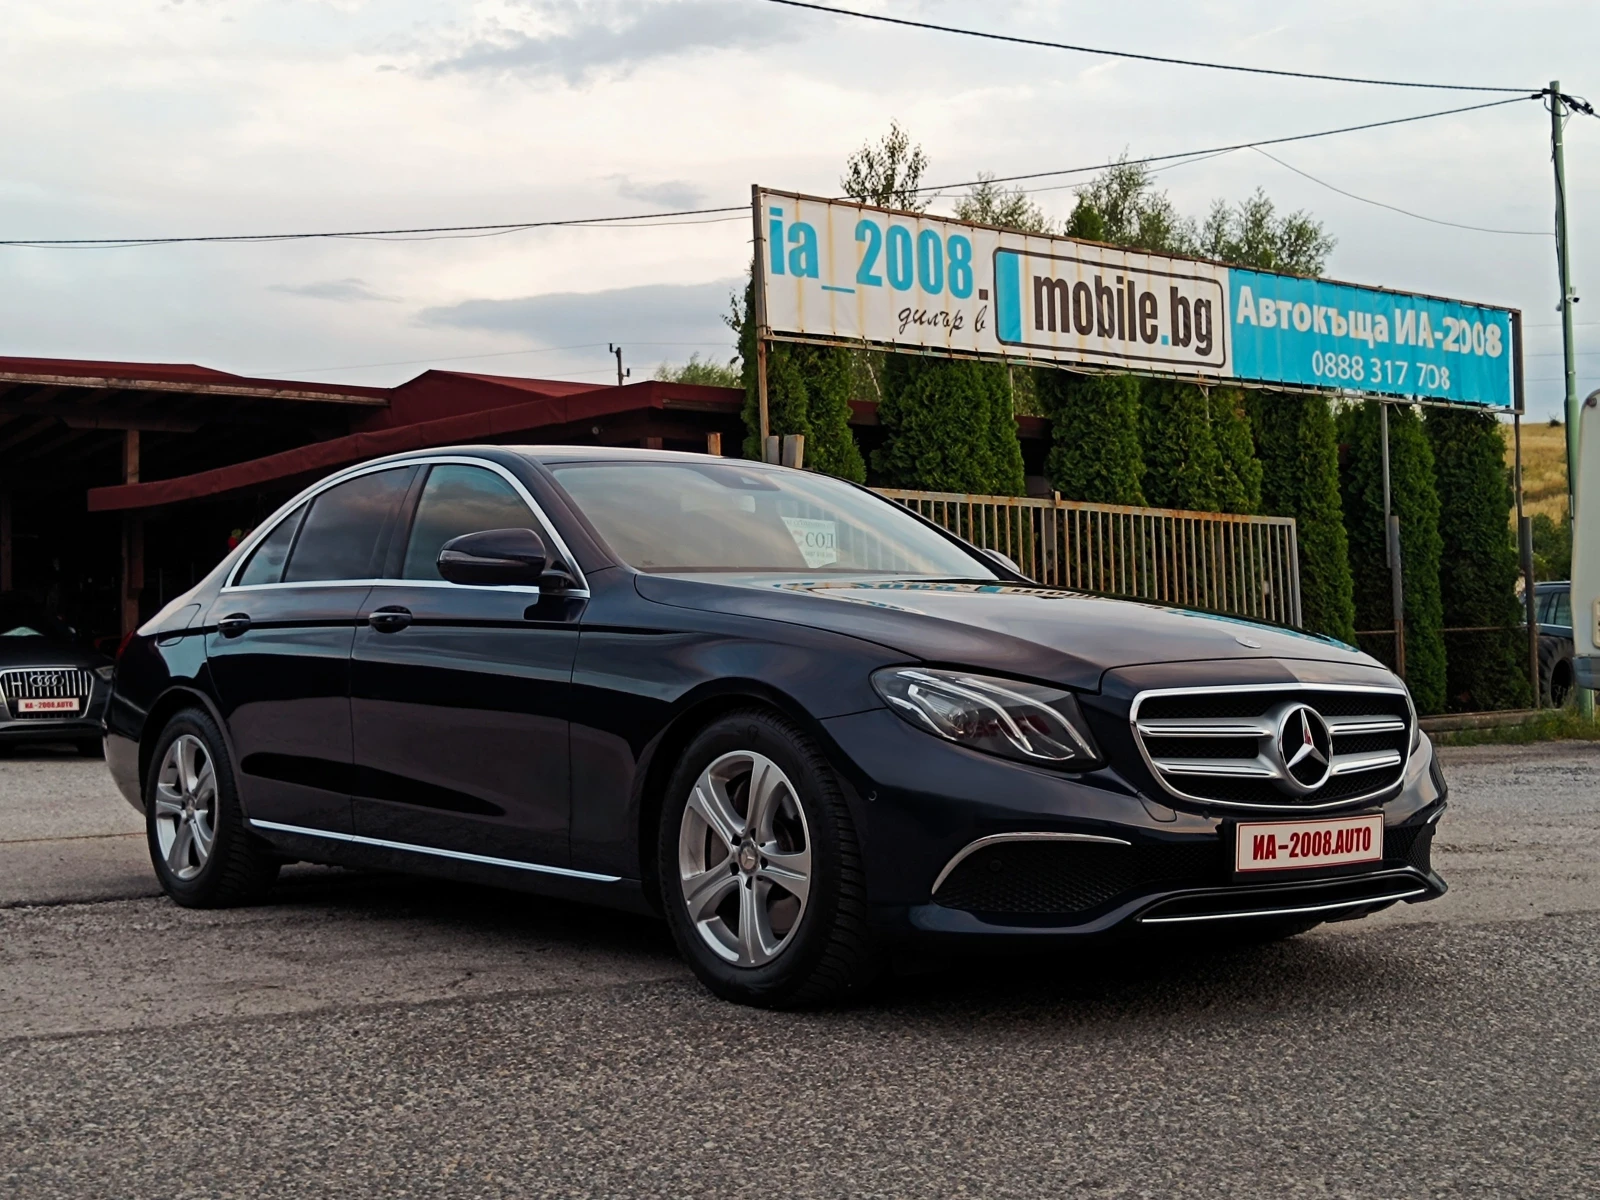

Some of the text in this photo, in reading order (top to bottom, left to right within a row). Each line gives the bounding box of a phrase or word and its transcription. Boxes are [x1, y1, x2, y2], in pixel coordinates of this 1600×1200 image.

[1034, 275, 1212, 356] mobile.bg
[1236, 286, 1502, 358] Автокъща ИА-2008
[1312, 350, 1450, 390] 0888 317 708
[1252, 826, 1371, 860] ИА-2008.AUTO
